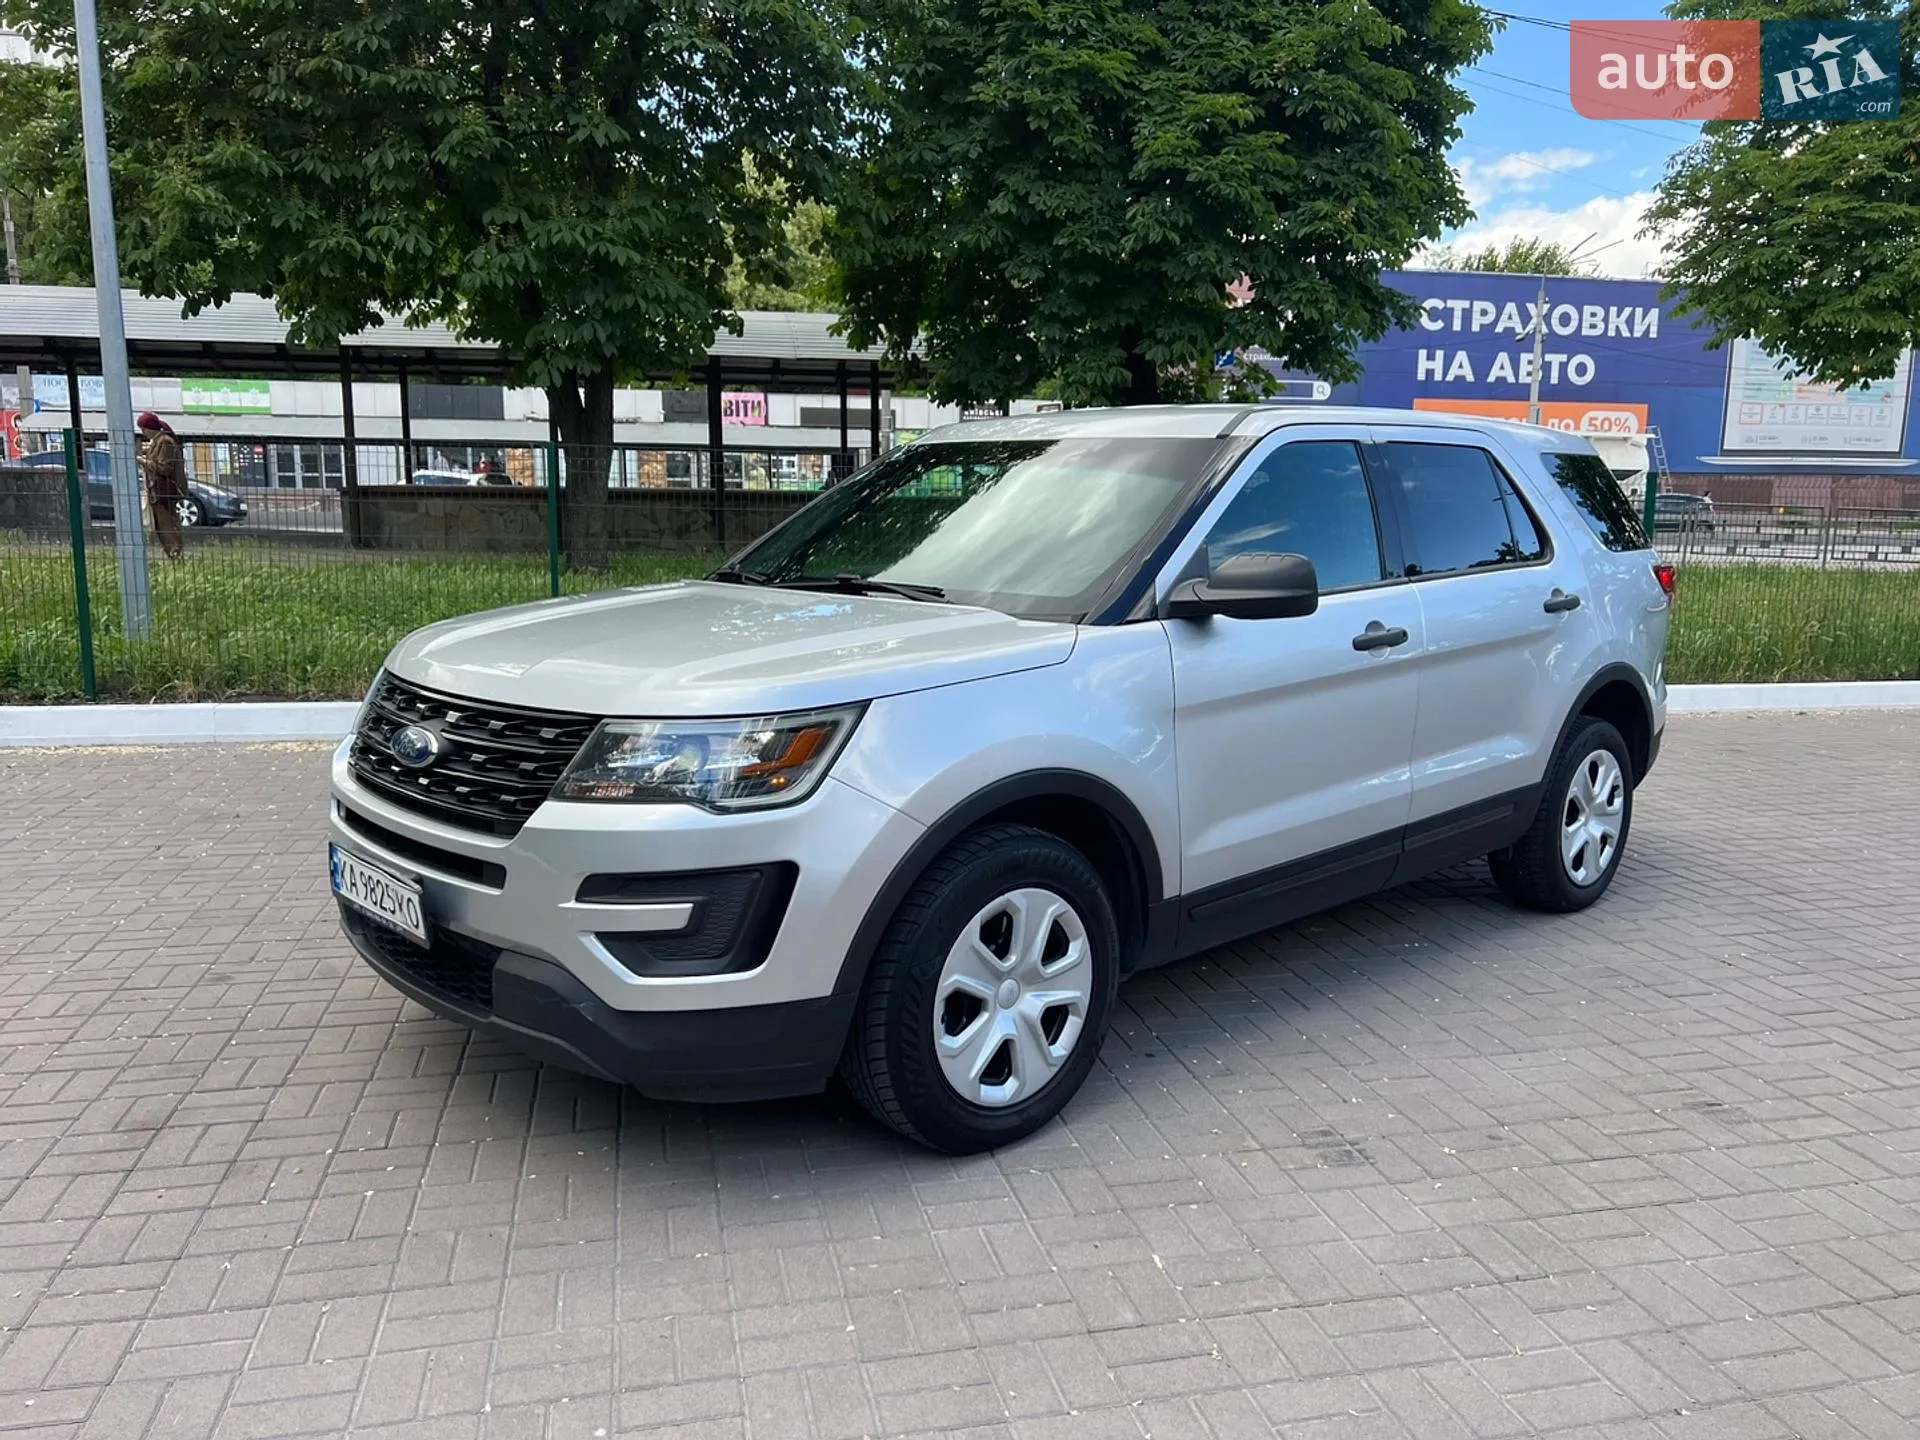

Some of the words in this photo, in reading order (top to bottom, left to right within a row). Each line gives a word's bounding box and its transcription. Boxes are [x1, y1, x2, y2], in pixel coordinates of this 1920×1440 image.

[1419, 298, 1660, 339] СТРАХОВКИ
[1416, 349, 1475, 383] НА
[1486, 351, 1596, 386] АВТО
[1587, 415, 1632, 434] 50%
